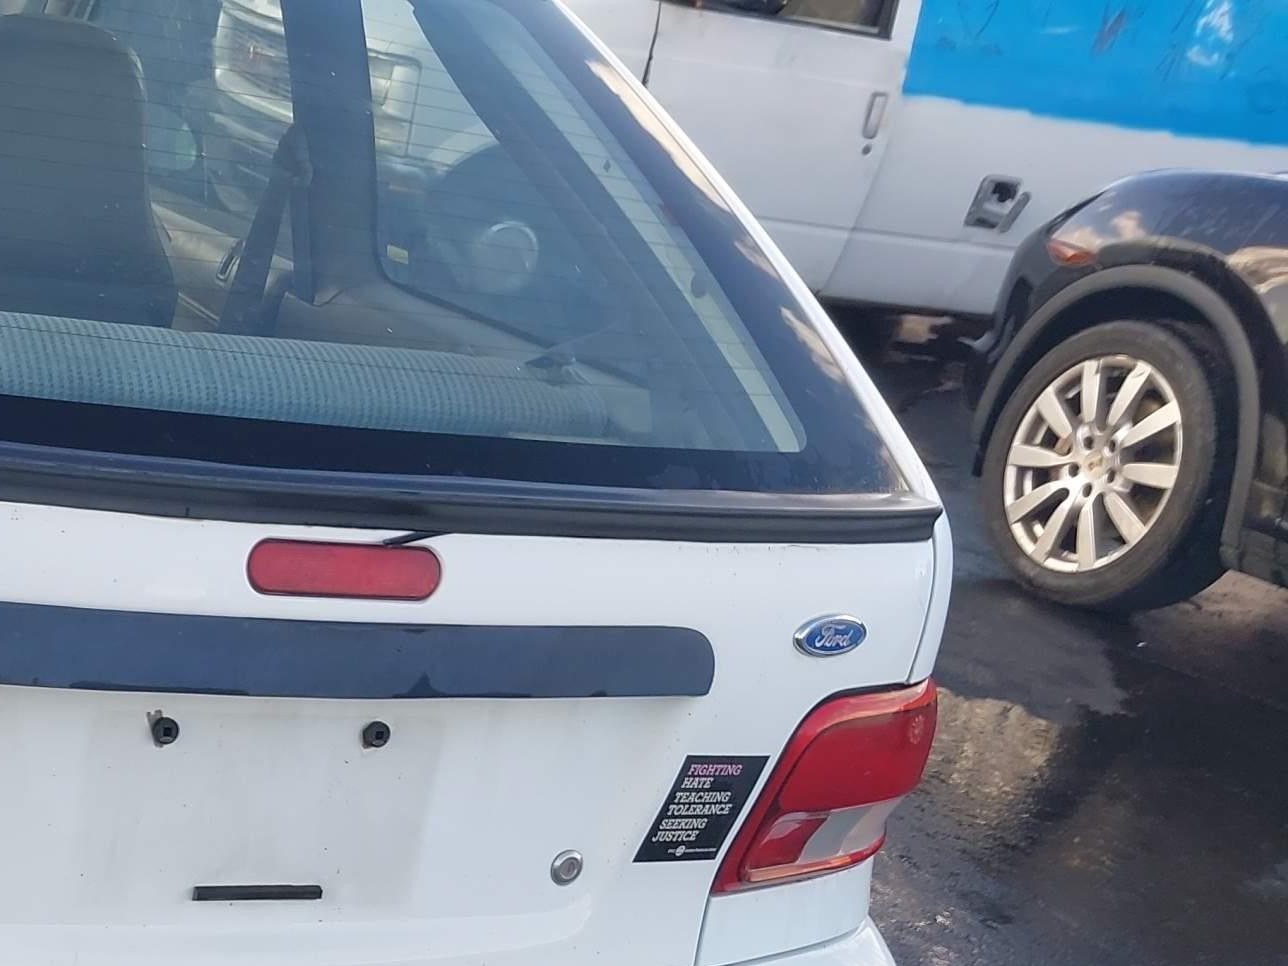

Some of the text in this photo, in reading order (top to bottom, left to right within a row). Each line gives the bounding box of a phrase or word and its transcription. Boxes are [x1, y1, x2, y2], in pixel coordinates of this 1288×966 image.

[814, 623, 854, 648] Ford
[688, 764, 742, 775] FIGHTING
[680, 777, 714, 789] HATE
[673, 792, 731, 803] TEACHING
[667, 804, 732, 815] TOLERANCE
[659, 819, 707, 829] SEEKING
[652, 831, 699, 841] JUSTICE
